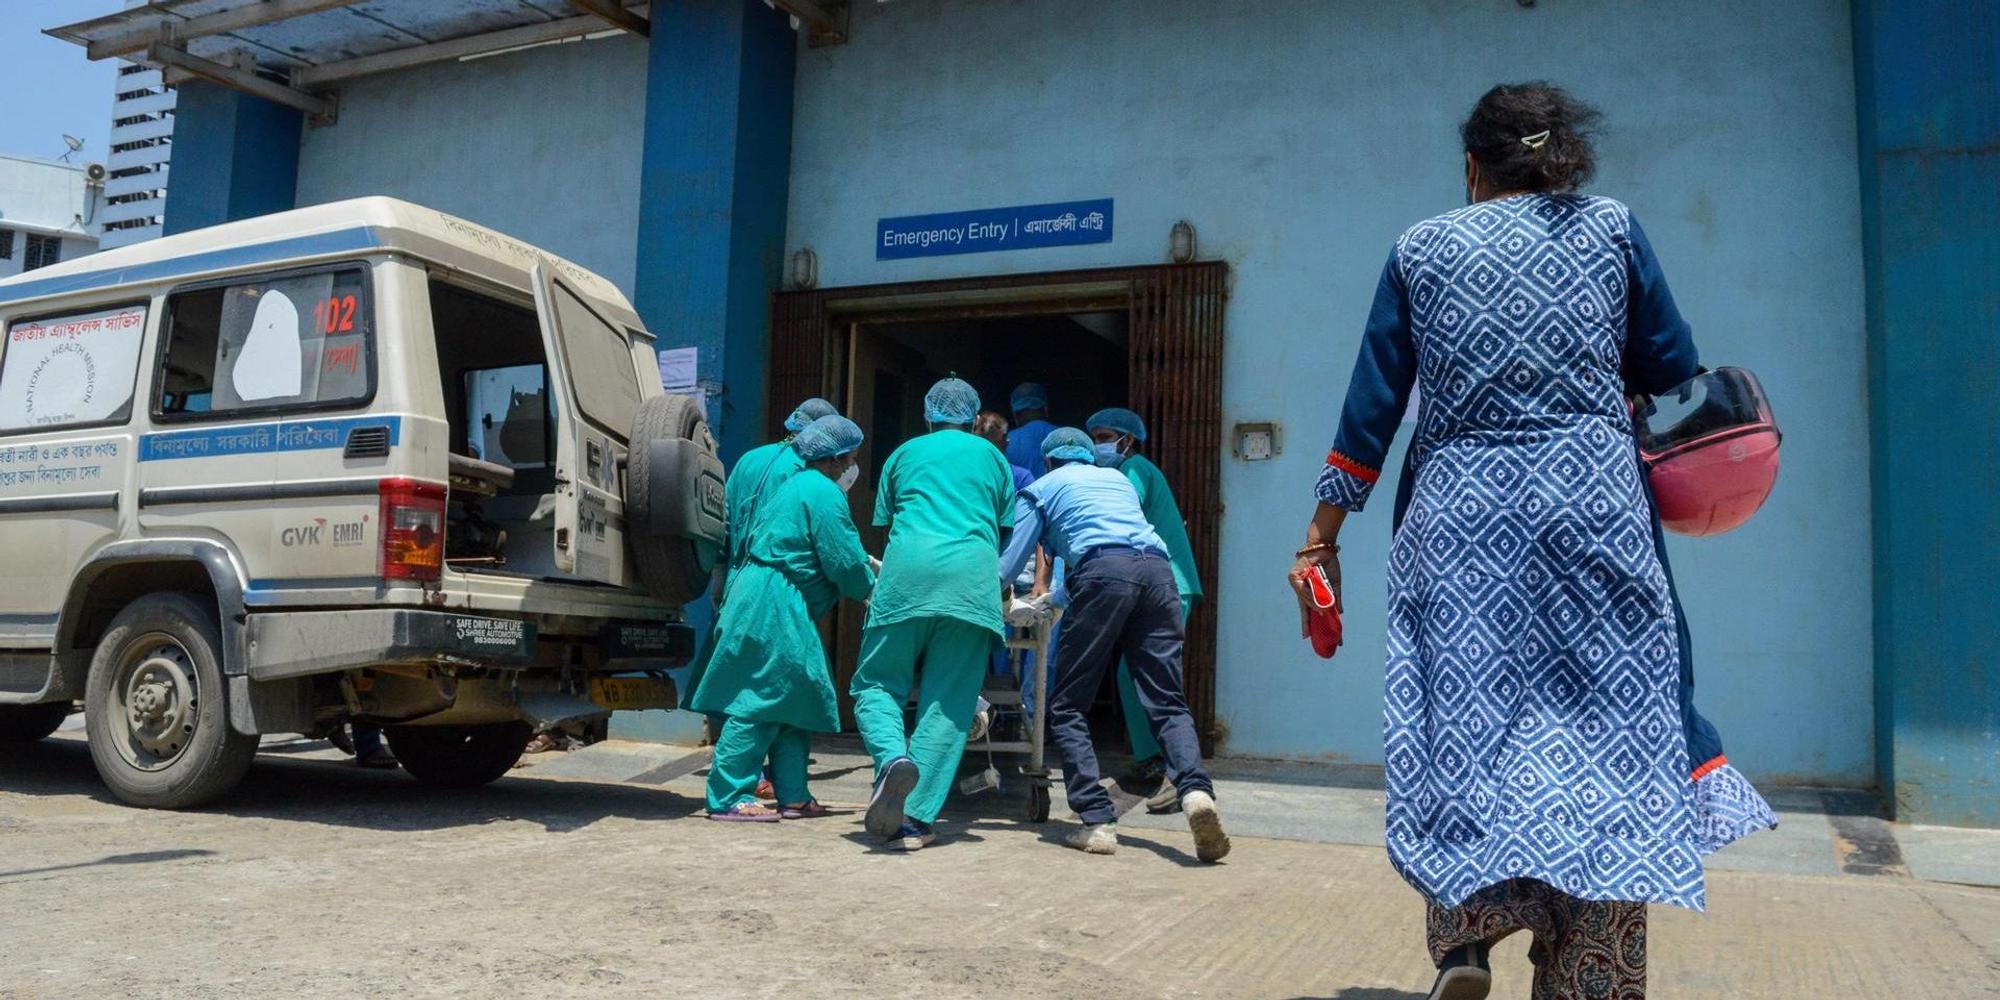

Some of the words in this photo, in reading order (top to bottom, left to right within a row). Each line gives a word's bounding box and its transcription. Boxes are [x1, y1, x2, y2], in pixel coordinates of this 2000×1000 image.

[884, 227, 965, 248] Emergency
[968, 221, 1008, 240] Entry
[12, 322, 47, 342] জাতীয়
[105, 310, 141, 329] সার্ভিস
[313, 294, 357, 337] 102
[25, 355, 51, 414] NATIONAL
[52, 342, 84, 358] HEALTH
[83, 351, 97, 404] MISSION
[217, 429, 270, 450] সরকারি
[18, 444, 38, 463] নারী
[42, 449, 50, 460] ও
[53, 446, 69, 460] এক
[79, 465, 101, 481] সেবা
[281, 526, 321, 547] GVK
[333, 522, 364, 542] EMRI
[456, 618, 472, 629] SAFE
[493, 620, 508, 630] SAVE
[465, 629, 486, 637] SHREE
[486, 630, 523, 639] AUTOMOTIVE
